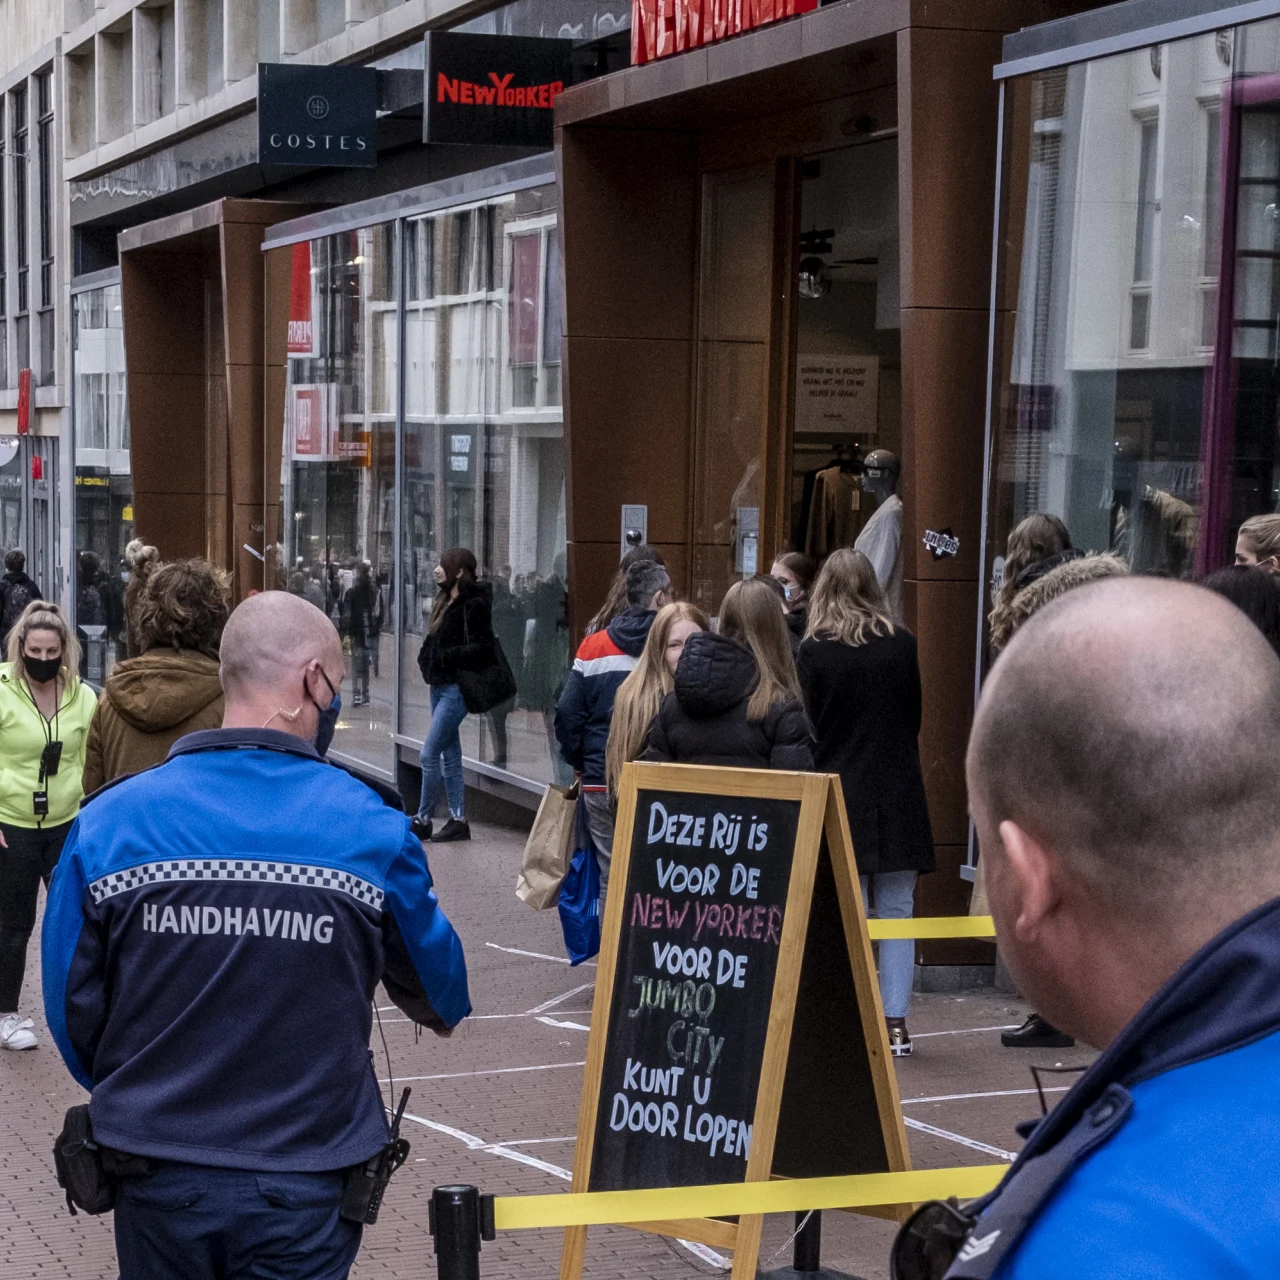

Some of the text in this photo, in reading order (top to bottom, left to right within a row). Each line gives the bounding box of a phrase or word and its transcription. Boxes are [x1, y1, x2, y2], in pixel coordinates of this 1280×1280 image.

[270, 133, 366, 151] COSTES
[647, 801, 706, 846] DEZE
[656, 858, 761, 900] VOOR DE
[142, 902, 334, 944] HANDHAVING
[630, 892, 782, 946] NEW YORKER
[652, 941, 748, 988] VOOR DE
[628, 975, 716, 1018] JUMBO
[623, 1058, 711, 1104] KUNT U
[610, 1092, 752, 1160] DOOR LOPEN
